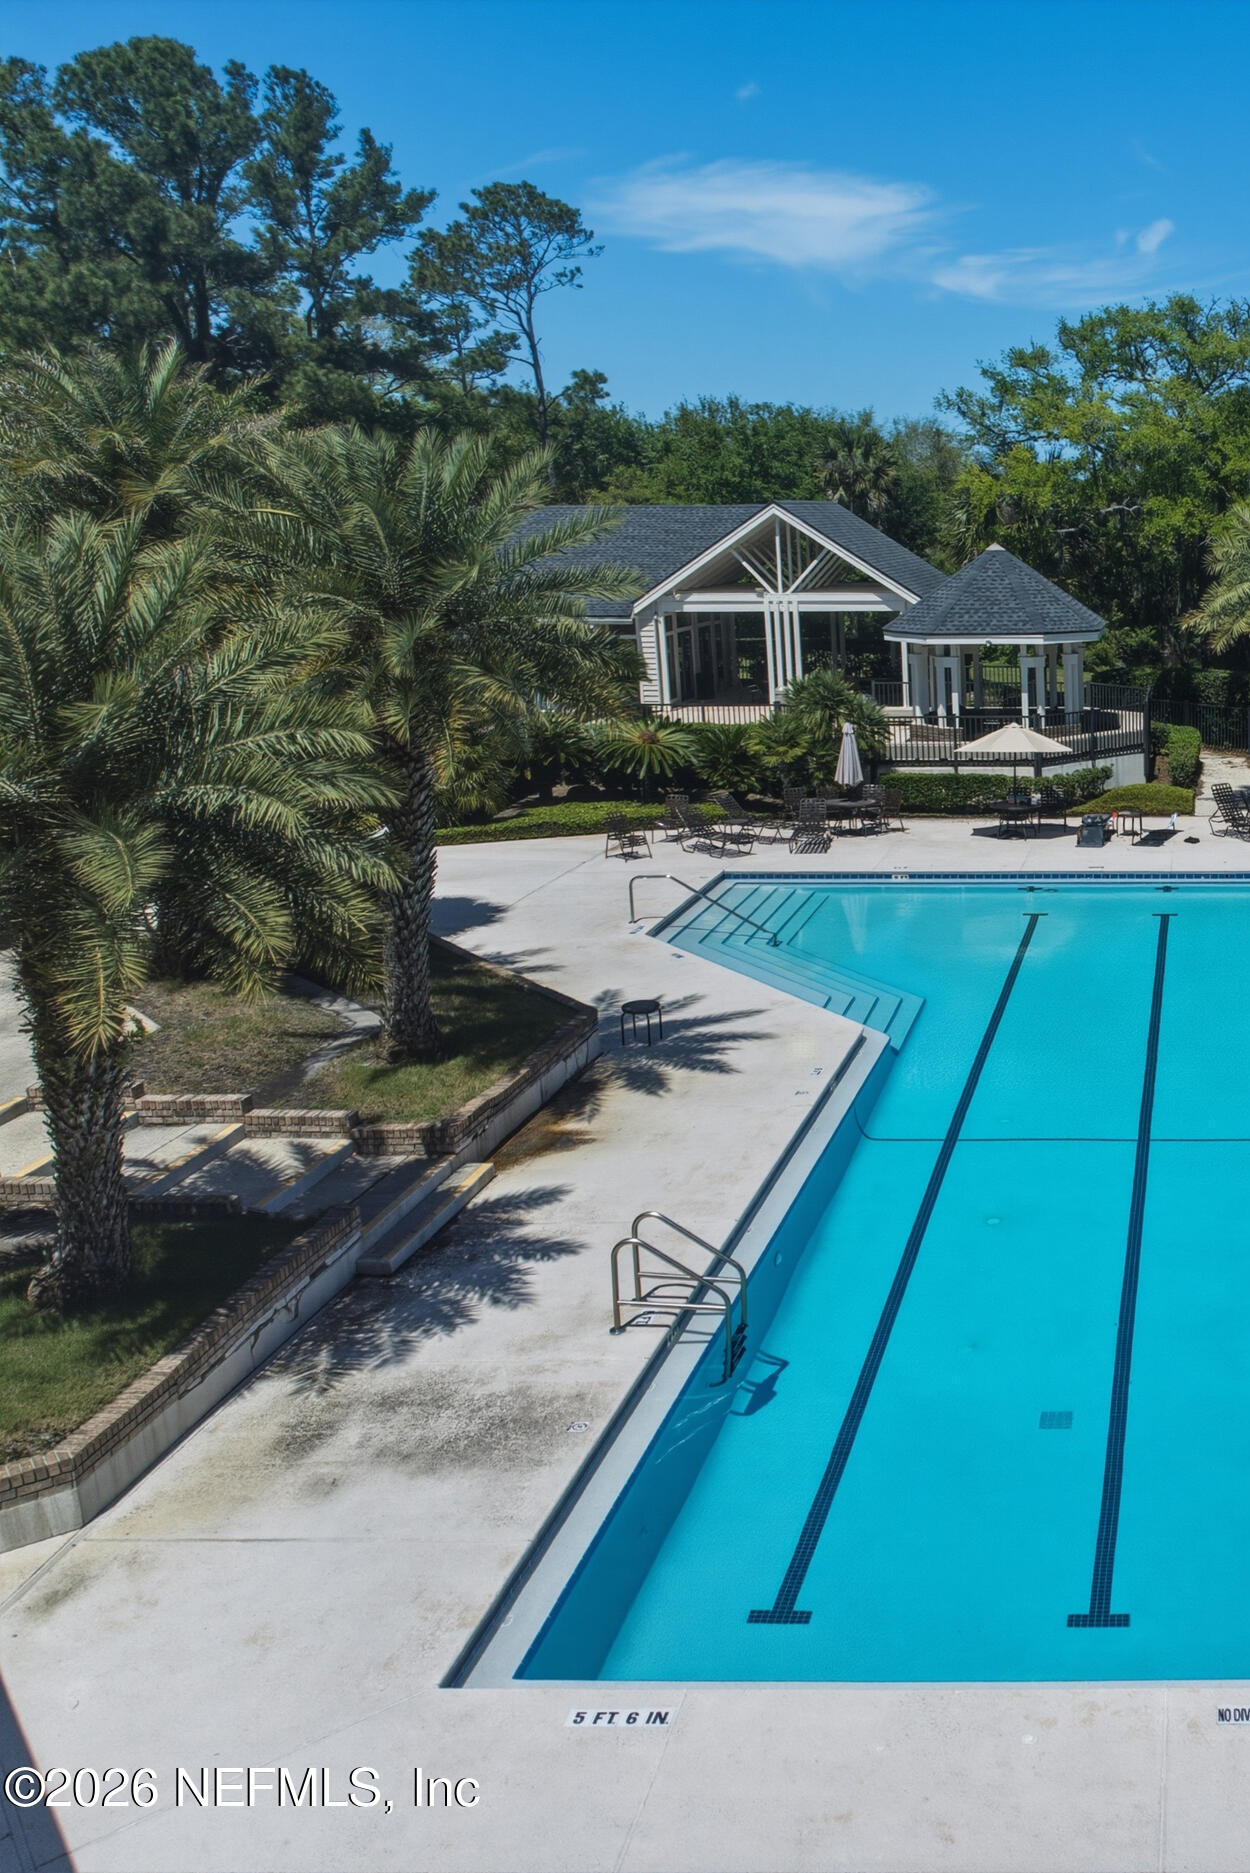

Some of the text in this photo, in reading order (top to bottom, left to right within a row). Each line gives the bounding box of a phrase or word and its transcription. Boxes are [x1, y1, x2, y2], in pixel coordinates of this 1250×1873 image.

[572, 1711, 588, 1725] 5
[625, 1711, 640, 1725] 6
[1217, 1707, 1232, 1722] NO
